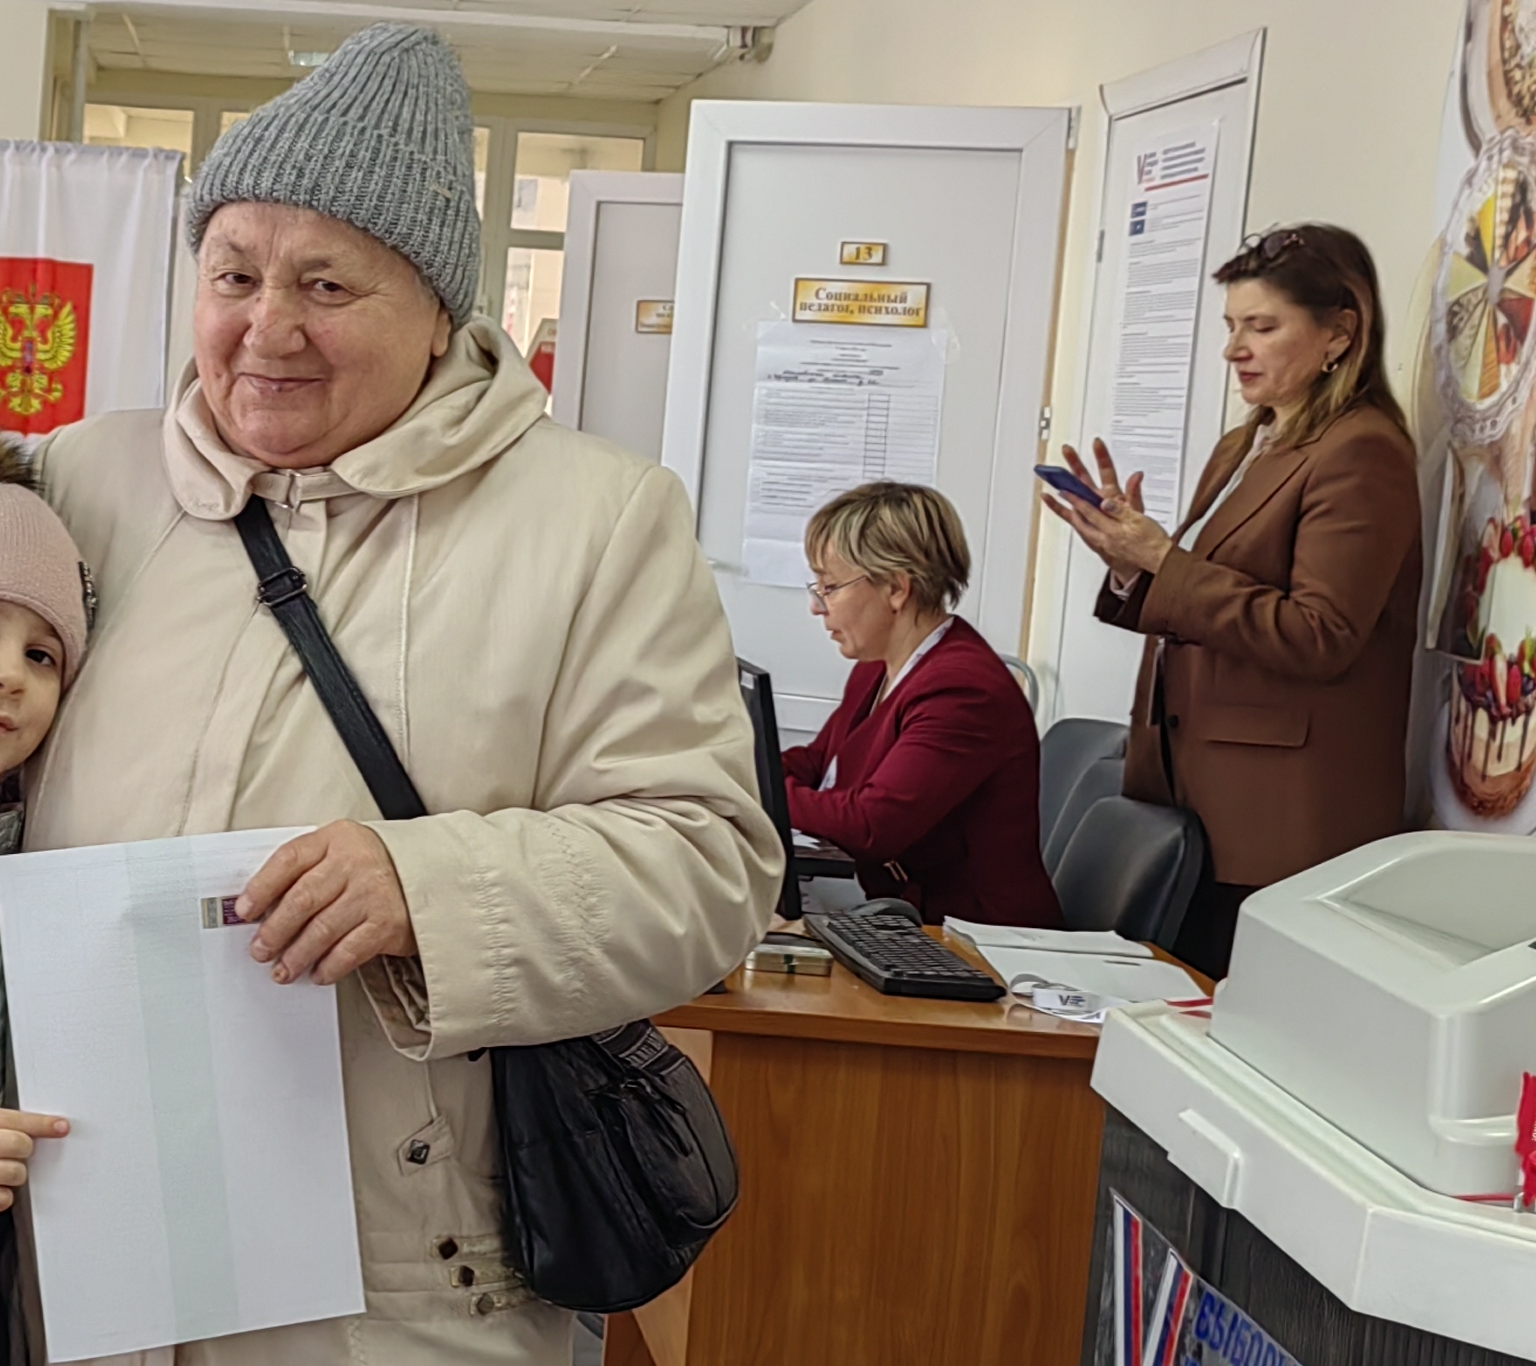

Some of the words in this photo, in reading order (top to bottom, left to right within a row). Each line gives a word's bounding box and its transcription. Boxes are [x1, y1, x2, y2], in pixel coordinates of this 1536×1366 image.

[854, 246, 873, 261] 13
[814, 287, 908, 304] Социальный
[799, 301, 855, 315] педагог,
[858, 304, 923, 318] психолог
